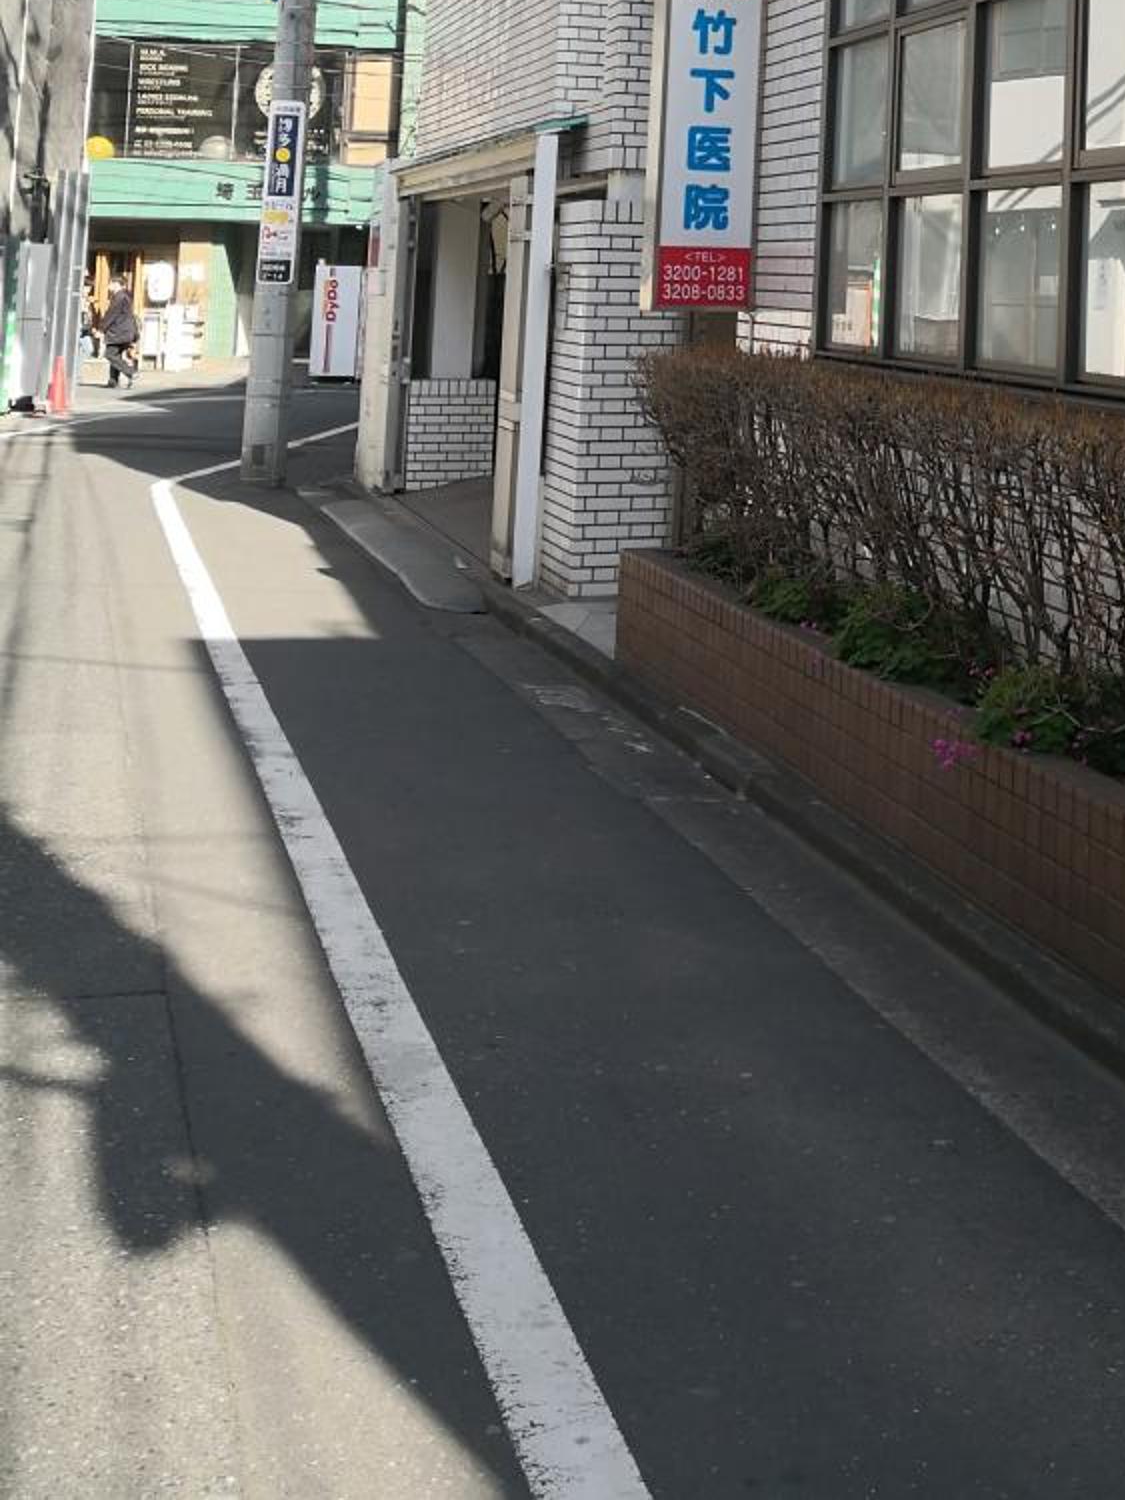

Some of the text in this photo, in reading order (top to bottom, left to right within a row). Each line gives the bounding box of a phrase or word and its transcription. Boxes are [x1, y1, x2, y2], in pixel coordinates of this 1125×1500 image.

[683, 8, 737, 232] 竹下医院
[662, 264, 744, 282] 3200-1281
[325, 279, 340, 322] DyDo
